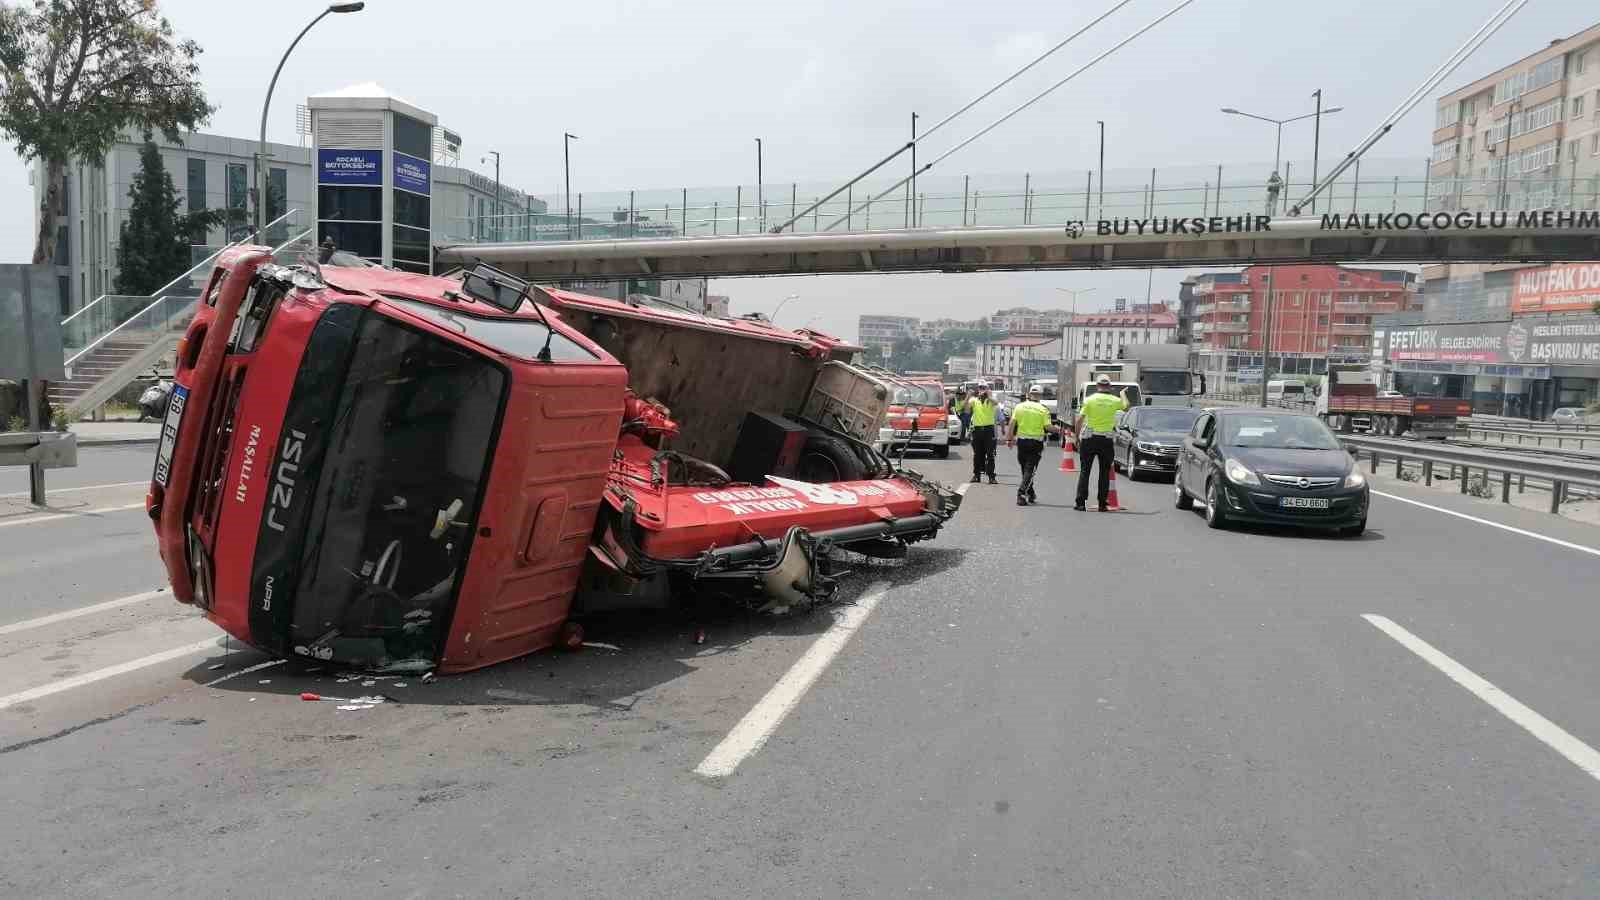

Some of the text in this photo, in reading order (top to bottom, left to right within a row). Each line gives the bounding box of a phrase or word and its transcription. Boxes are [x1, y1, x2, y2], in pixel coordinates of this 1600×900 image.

[1097, 212, 1272, 237] BÜYÜKŞEHİR
[1519, 268, 1575, 293] MUTFAK
[1389, 328, 1438, 349] EFETÜRK
[1441, 334, 1501, 349] BELGELENDİRME
[1562, 322, 1600, 336] YETERLİLİ
[1530, 343, 1580, 362] BAŞVURU
[156, 395, 186, 486] 58 EF 760
[236, 424, 262, 503] MAŞALLAH
[262, 575, 275, 612] NPR
